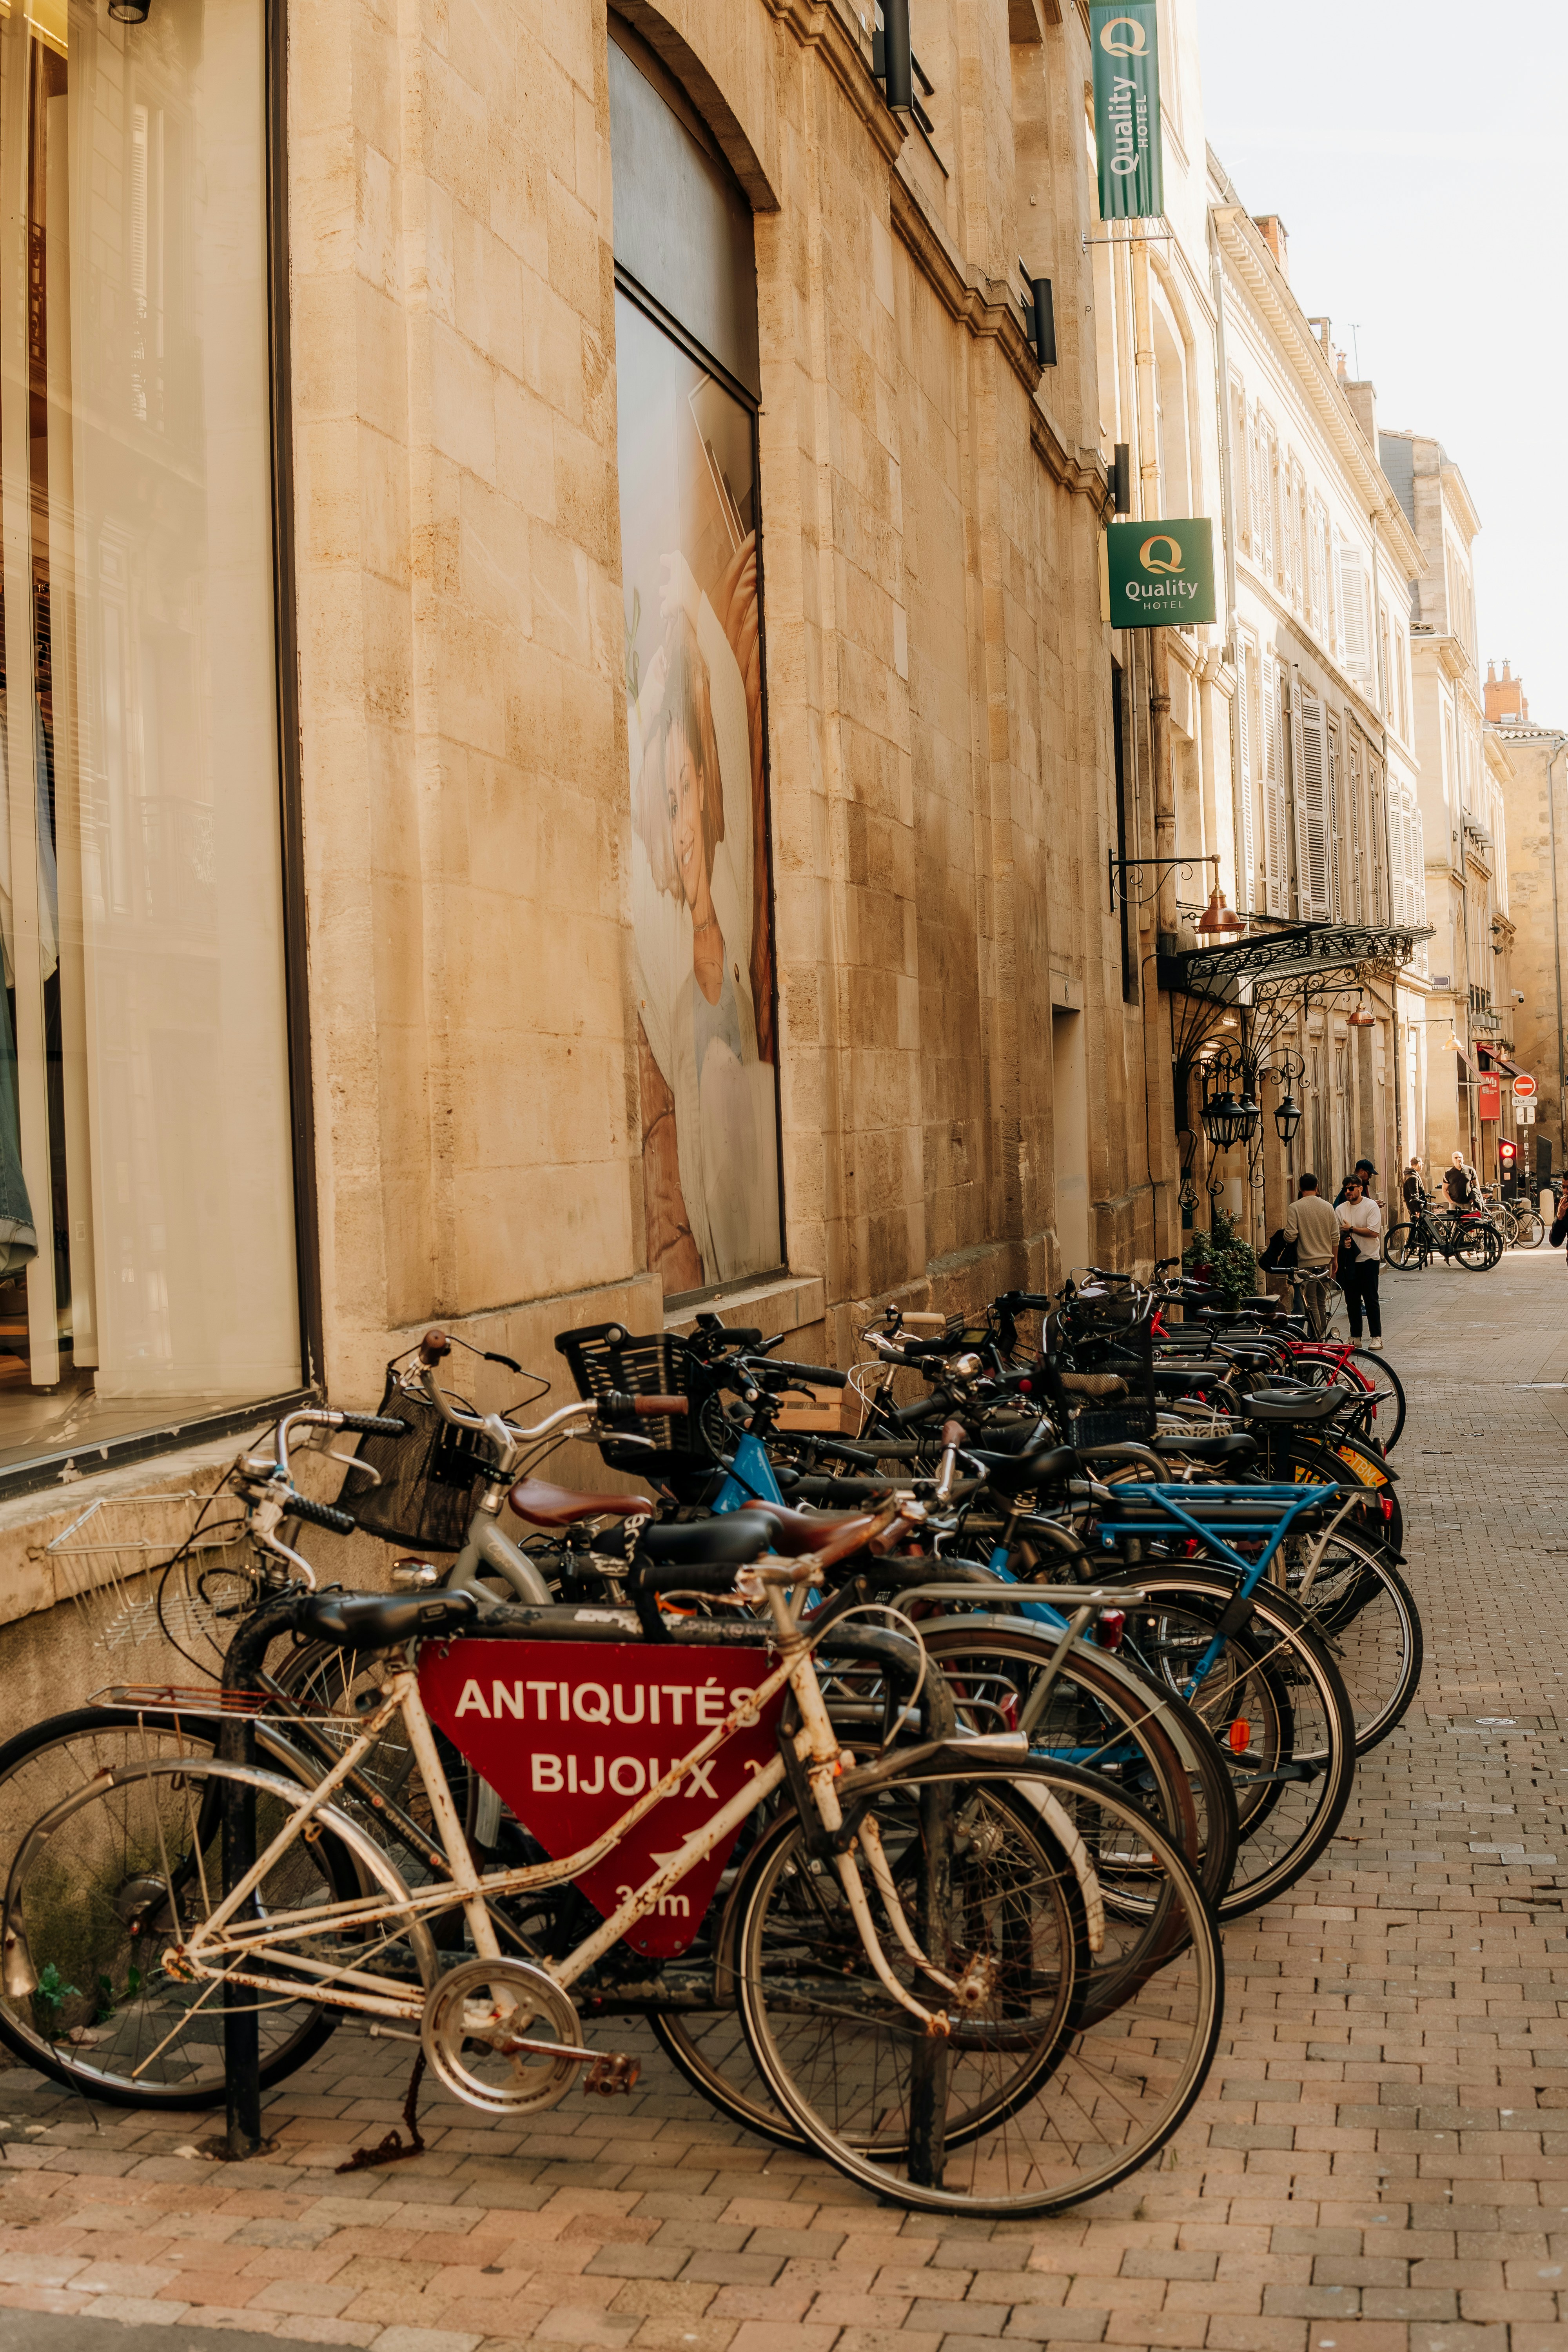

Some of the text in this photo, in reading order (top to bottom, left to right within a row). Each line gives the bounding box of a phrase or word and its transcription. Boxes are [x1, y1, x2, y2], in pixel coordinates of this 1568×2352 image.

[1100, 17, 1150, 58] Q
[1108, 76, 1140, 175] Quality
[1136, 94, 1148, 148] HOTEL
[1139, 535, 1186, 574] Q
[1125, 579, 1198, 601] Quality
[1144, 601, 1185, 610] HOTEL
[1352, 1453, 1377, 1486] TBM
[454, 1677, 760, 1728] ANTIQUITÉS
[531, 1753, 719, 1799] BIJOUX
[615, 1885, 690, 1917] 3m
